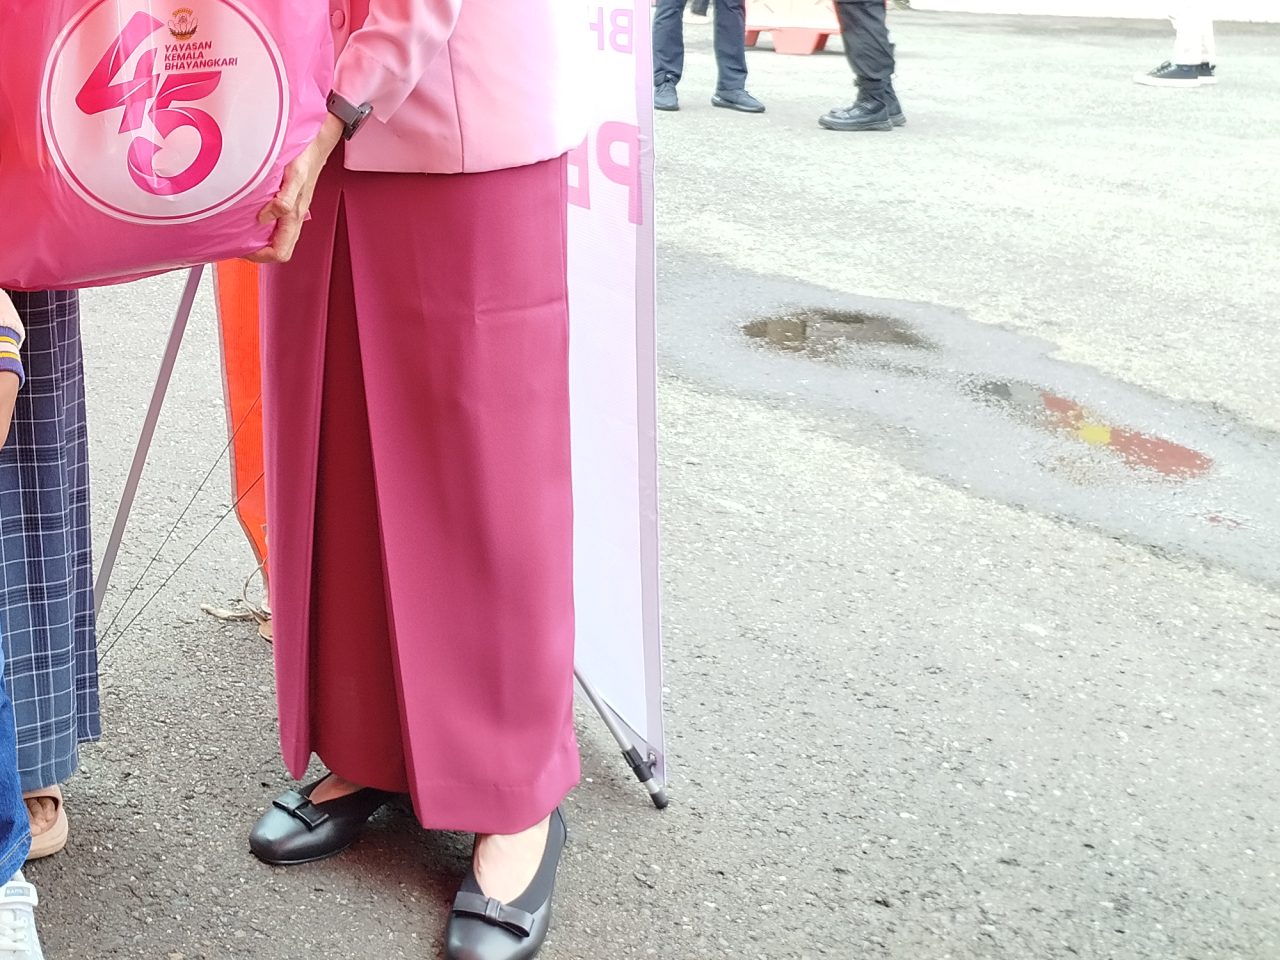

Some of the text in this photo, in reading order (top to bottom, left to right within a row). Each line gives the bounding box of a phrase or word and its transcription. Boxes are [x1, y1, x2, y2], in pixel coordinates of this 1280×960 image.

[164, 41, 212, 53] YAYASAN
[164, 51, 204, 62] KEMALA
[164, 57, 238, 71] BHAYANGKARI
